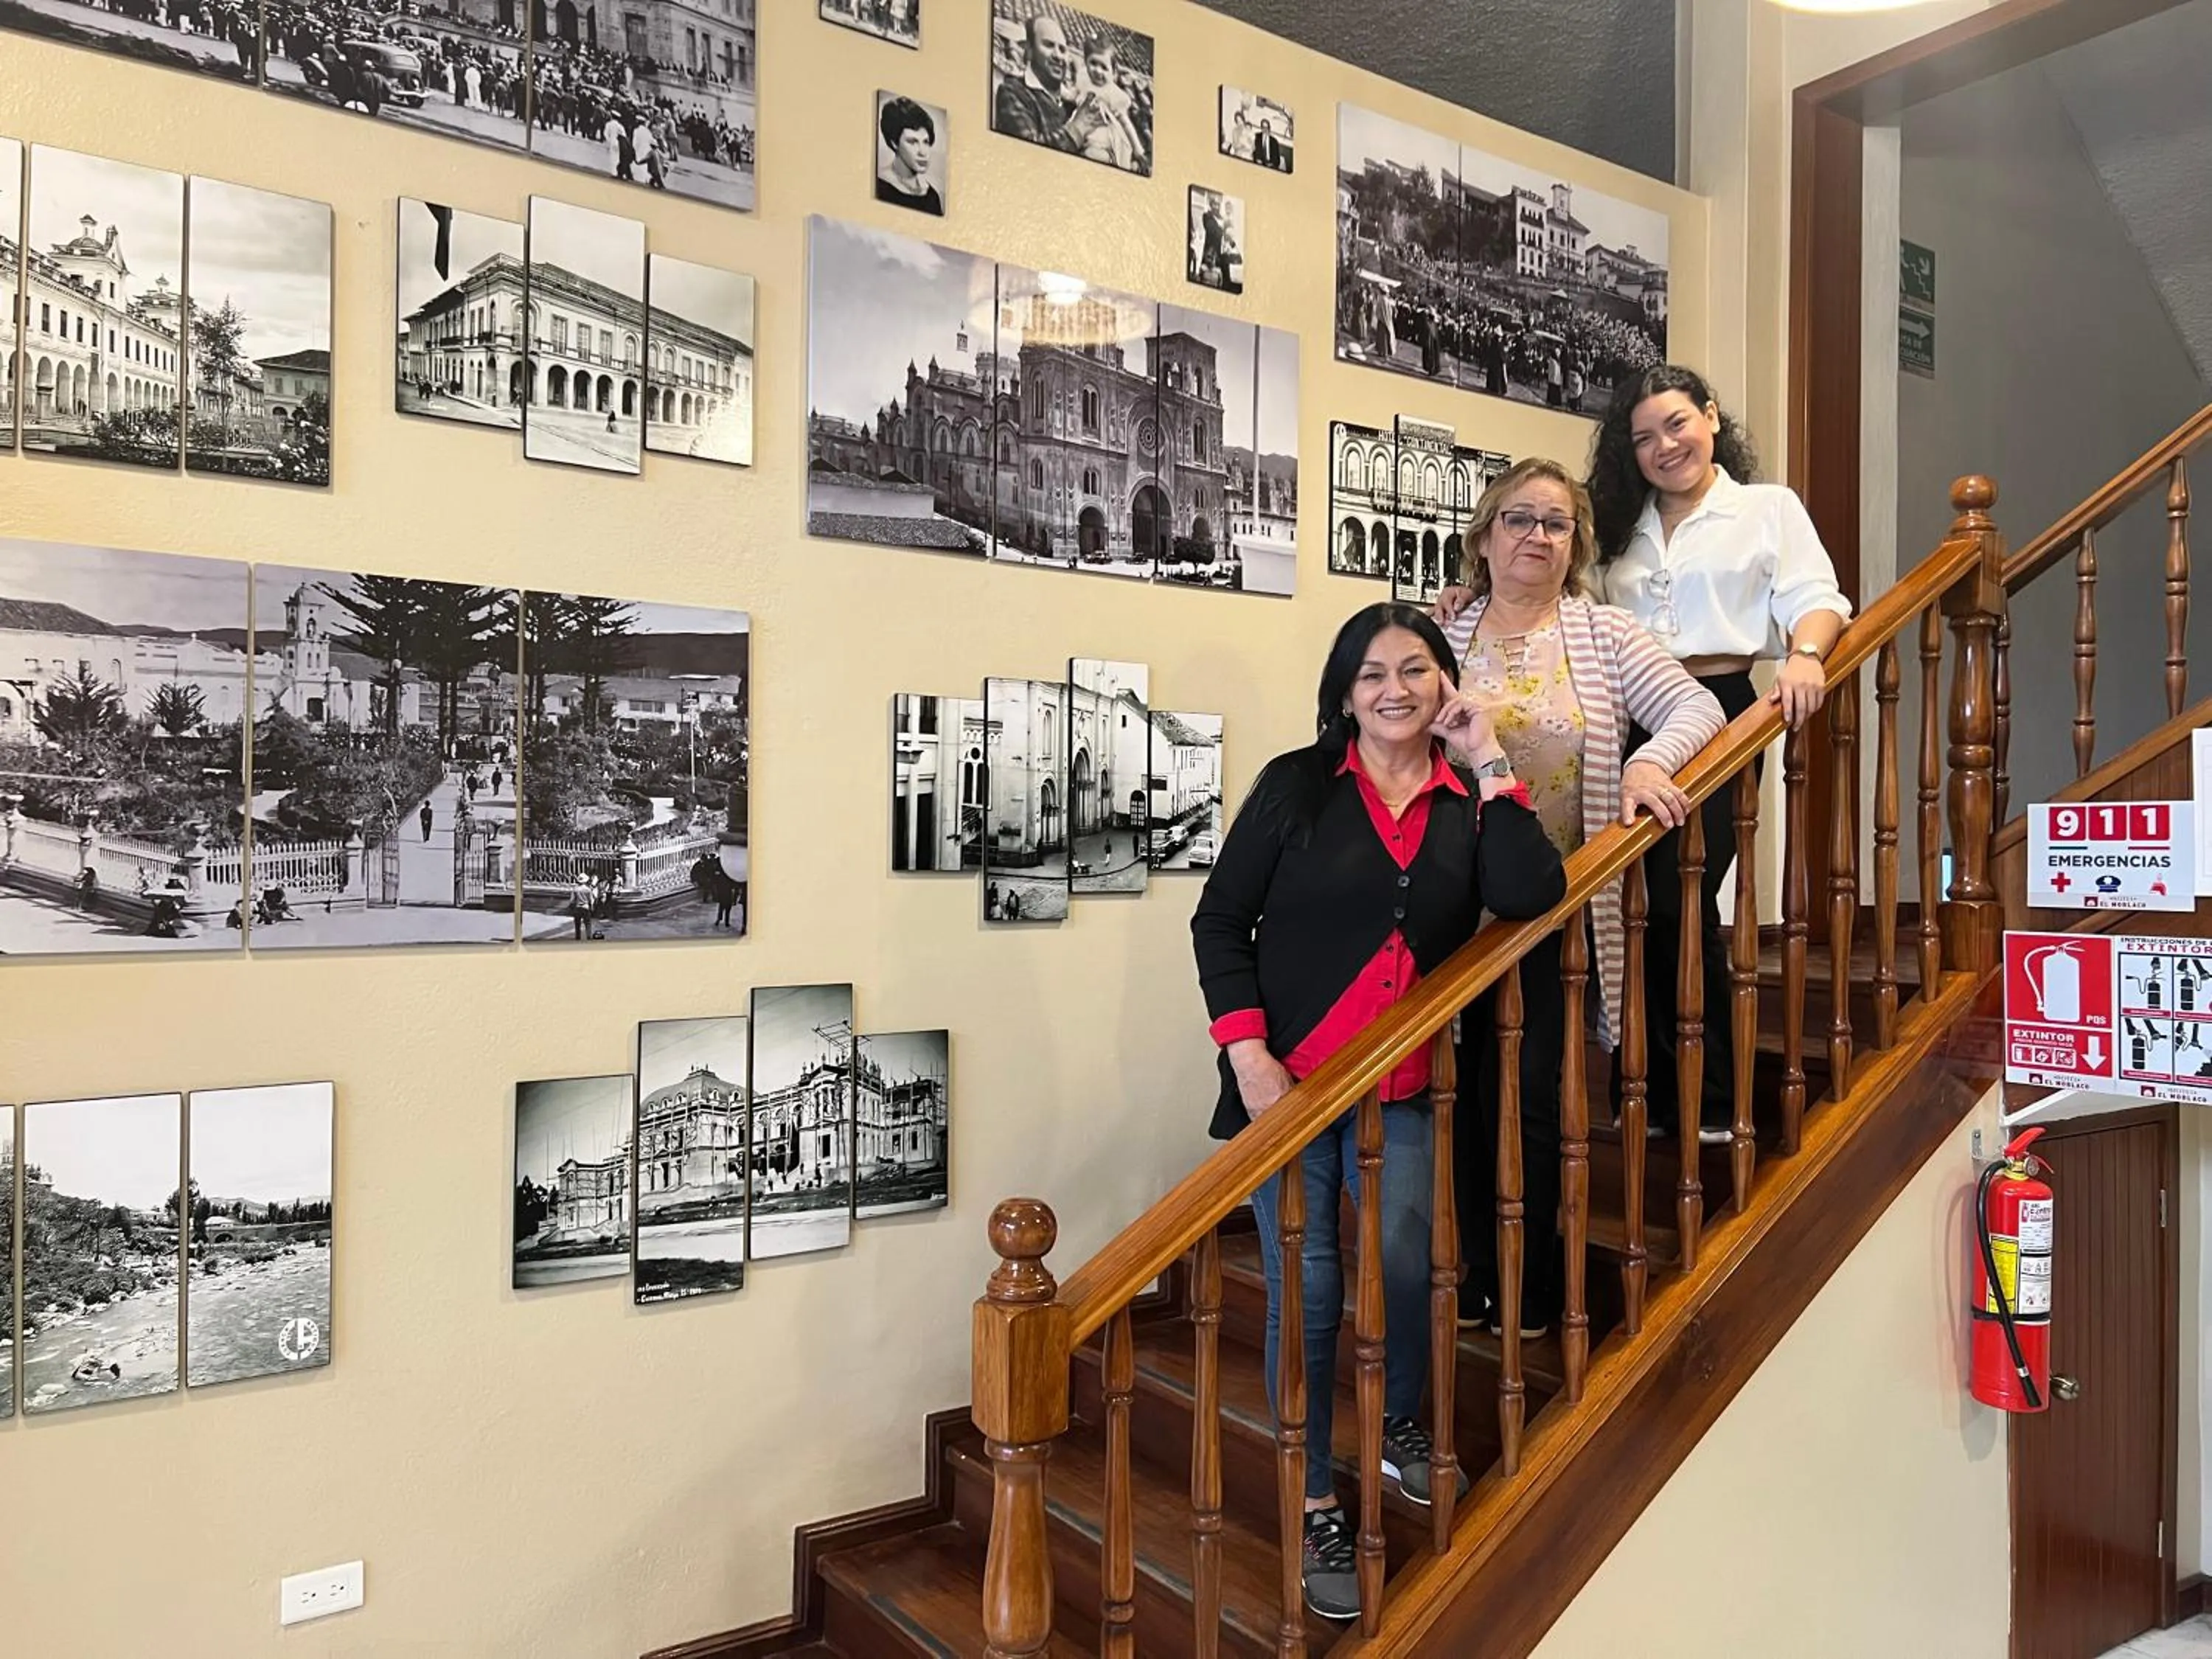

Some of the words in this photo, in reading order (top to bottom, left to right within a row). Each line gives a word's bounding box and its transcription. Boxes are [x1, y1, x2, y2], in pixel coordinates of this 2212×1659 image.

[2056, 807, 2157, 837] 911
[2048, 855, 2171, 868] EMERGENCIAS
[2120, 937, 2193, 945] INSTRUCCIONES
[2126, 944, 2212, 953] EXTINTOR
[2012, 1029, 2075, 1043] EXTINTOR
